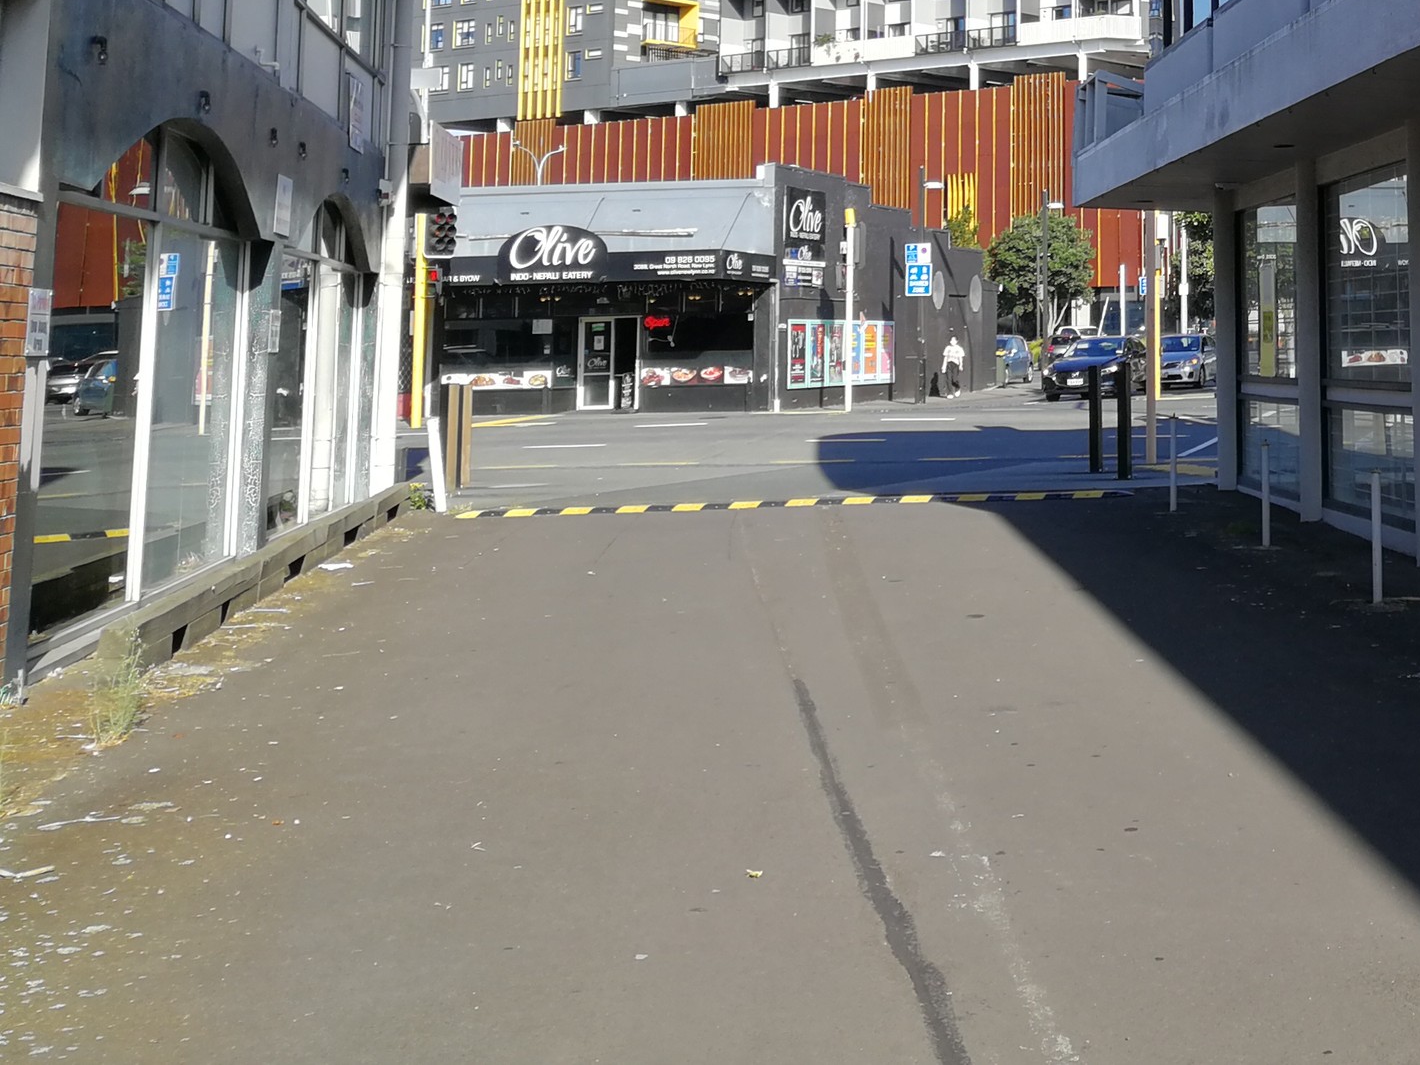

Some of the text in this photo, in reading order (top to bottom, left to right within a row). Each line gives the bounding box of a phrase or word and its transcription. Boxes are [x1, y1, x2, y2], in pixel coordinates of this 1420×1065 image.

[789, 196, 822, 233] Olive
[509, 226, 597, 269] Olive
[562, 271, 593, 279] EATERY
